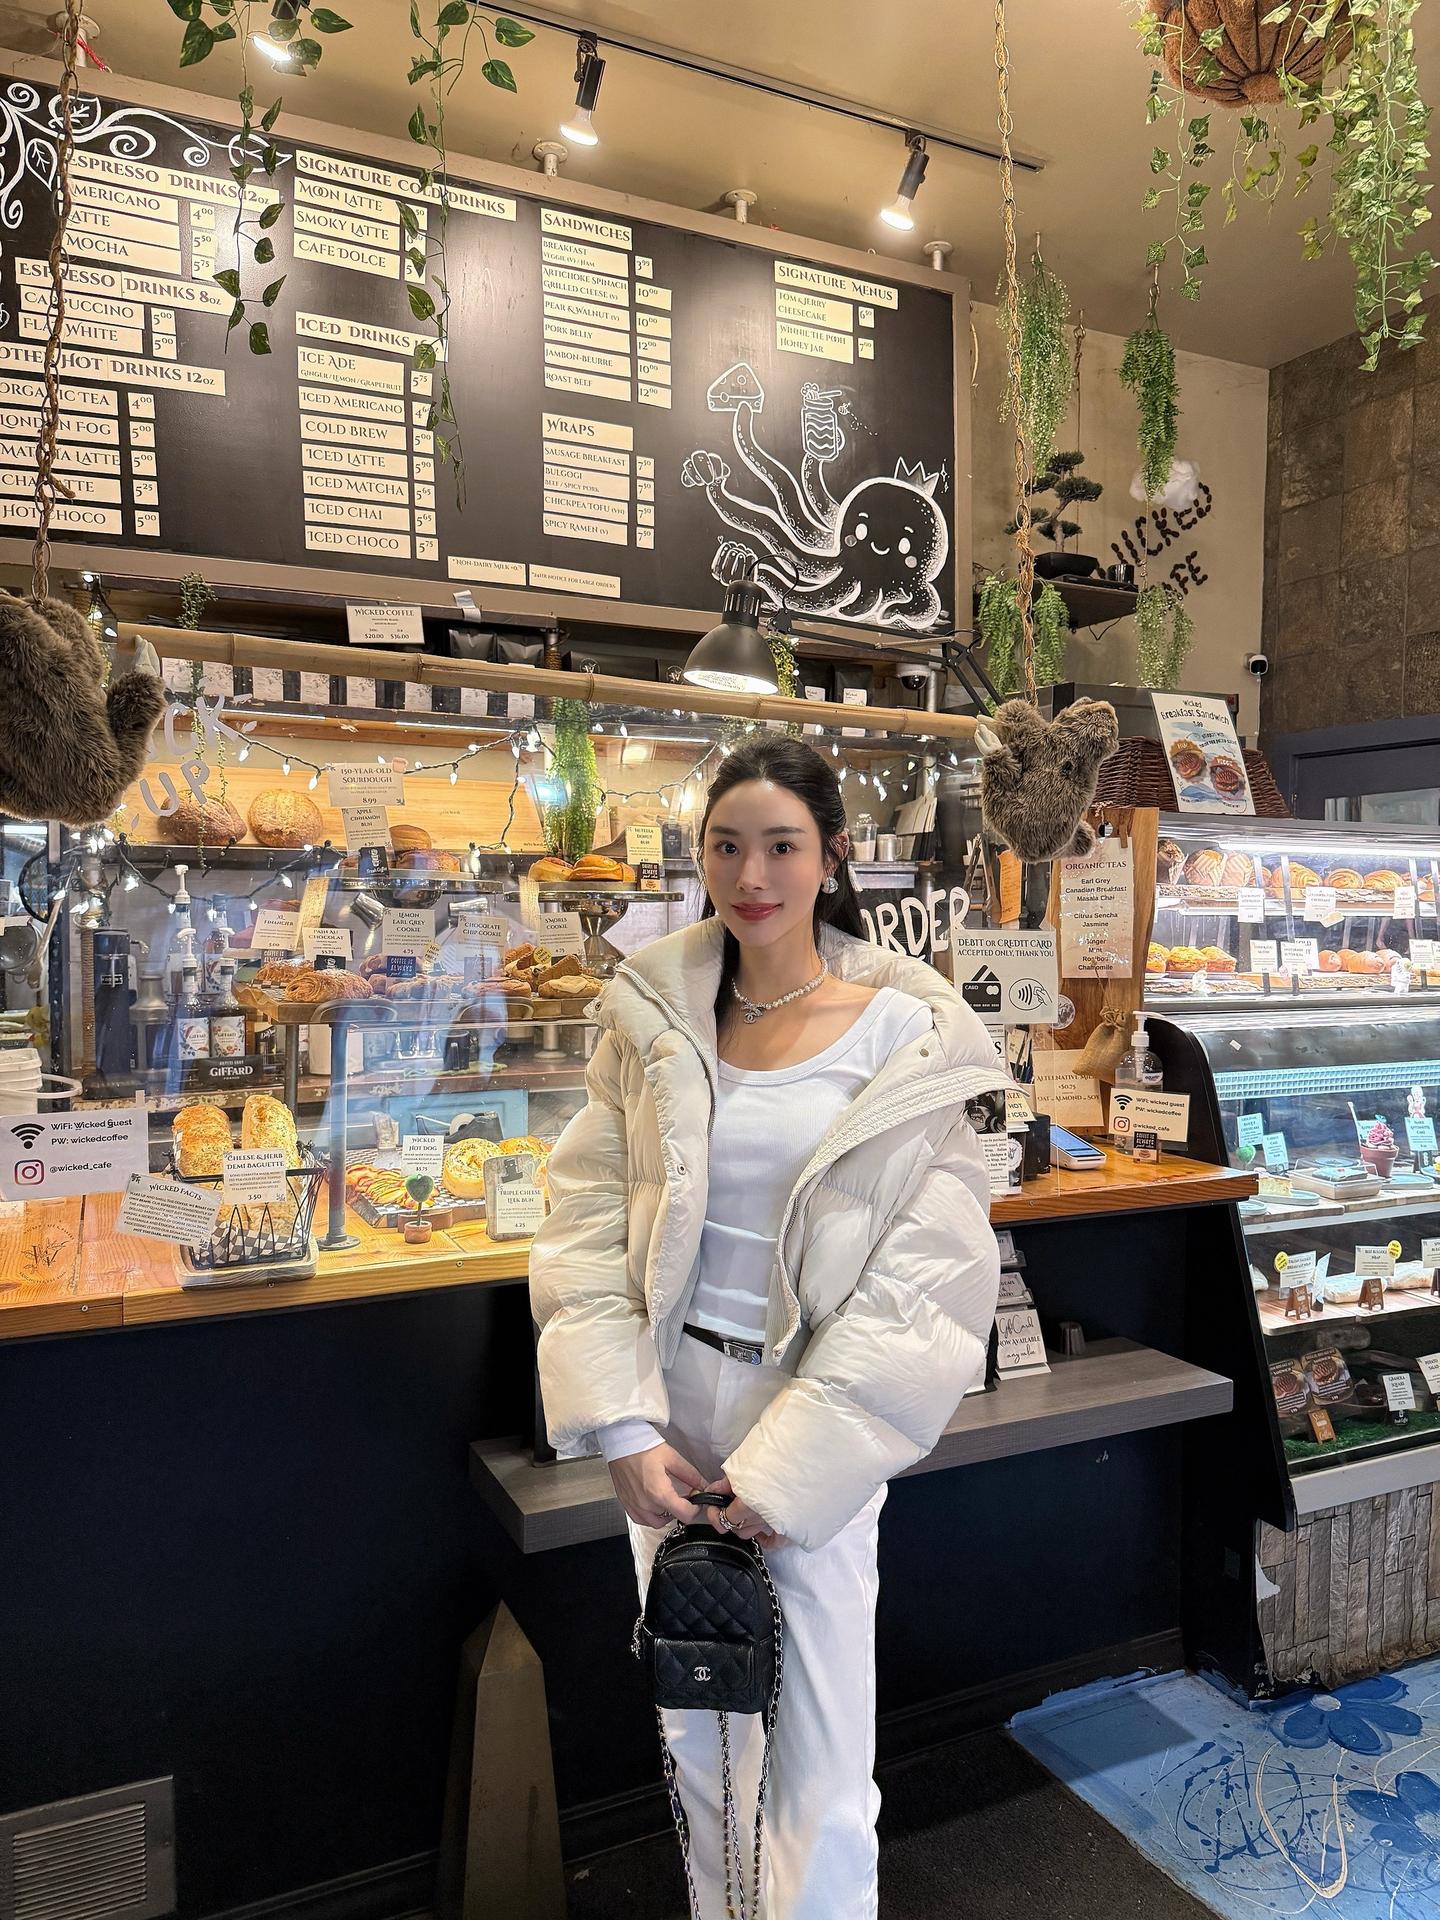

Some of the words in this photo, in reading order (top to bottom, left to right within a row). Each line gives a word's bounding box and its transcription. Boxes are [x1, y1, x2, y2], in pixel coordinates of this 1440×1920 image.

[168, 173, 237, 199] DRINKS
[298, 155, 392, 187] SIGNATURE
[448, 191, 506, 214] DRINKS
[299, 180, 340, 199] MOON
[344, 194, 383, 212] LATTE
[296, 211, 347, 230] SMOKY
[351, 223, 389, 240] LATTE
[543, 213, 630, 242] SANDWICHES
[65, 232, 128, 256] MOCHA
[543, 240, 587, 256] BREAKFAST
[298, 239, 335, 257] CAFE
[338, 247, 386, 268] DOLCE
[543, 268, 590, 283] ARTICHOKE
[592, 276, 627, 291] SPINACH
[779, 266, 846, 290] SIGNATURE
[852, 281, 893, 301] MENUS
[123, 277, 195, 302] DRINKS
[543, 280, 578, 293] GRILLED
[580, 287, 608, 299] CHEESE
[779, 292, 797, 302] TOM
[803, 297, 826, 309] JERRY
[545, 301, 566, 312] PEAR
[576, 306, 609, 320] WALNUT
[778, 305, 826, 321] CHEESECAKE
[65, 322, 118, 341] WHITE
[298, 317, 342, 335] ICED
[348, 325, 410, 348] DRINKS
[545, 323, 567, 334] PORK
[570, 328, 593, 339] BELLY
[780, 337, 808, 350] HONEY
[810, 343, 824, 353] JAR
[61, 353, 103, 370] HOT
[110, 360, 182, 381] DRINKS
[300, 351, 325, 363] ICE
[329, 355, 356, 371] ADE
[546, 372, 572, 383] ROAST
[574, 378, 592, 387] BEEF
[77, 391, 110, 406] TEA
[301, 392, 331, 404] ICED
[334, 395, 403, 414] AMERICANO
[0, 415, 71, 431] LONDN
[76, 421, 111, 435] FOG
[305, 420, 346, 435] COLD
[350, 424, 388, 440] BREW
[546, 417, 595, 436] WRAPS
[76, 451, 120, 466] LATTE
[306, 449, 343, 462] ICED
[347, 453, 385, 467] LATTE
[545, 448, 582, 459] SAUSAGE
[582, 453, 625, 466] BREAKFAST
[545, 468, 582, 479] BULGOGI
[307, 476, 343, 489] ICED
[346, 478, 404, 497] MATCHA
[309, 503, 344, 516] ICED
[347, 506, 382, 521] CHAI
[545, 496, 586, 509] CHICKPEA
[587, 502, 610, 513] TOFU
[545, 520, 568, 529] SPICY
[570, 522, 598, 533] RAMEN
[307, 531, 343, 544] ICED
[346, 535, 399, 550] CHOCO
[354, 608, 385, 616] WICKED
[1161, 708, 1195, 720] Breakfast
[1196, 709, 1229, 725] Sandwich
[139, 760, 210, 817] UP
[1065, 861, 1104, 871] ORGANIC
[1065, 886, 1095, 894] Canadian
[958, 938, 984, 947] DEBIT
[997, 939, 1029, 948] CREDIT
[1030, 940, 1052, 949] CARD
[210, 1066, 253, 1077] GIFFARD
[1147, 1108, 1181, 1116] wickedcoffee
[50, 1122, 73, 1130] WiFi:
[74, 1121, 106, 1131] Wicked
[1133, 1123, 1170, 1131] @wicked_cafe
[71, 1134, 129, 1144] wickedcoffee
[227, 1154, 255, 1162] CHEESE
[50, 1162, 112, 1174] @wicked_cafe
[149, 1183, 180, 1193] WICKED
[180, 1188, 202, 1201] FACTS
[1012, 1336, 1040, 1345] AVAILABLE
